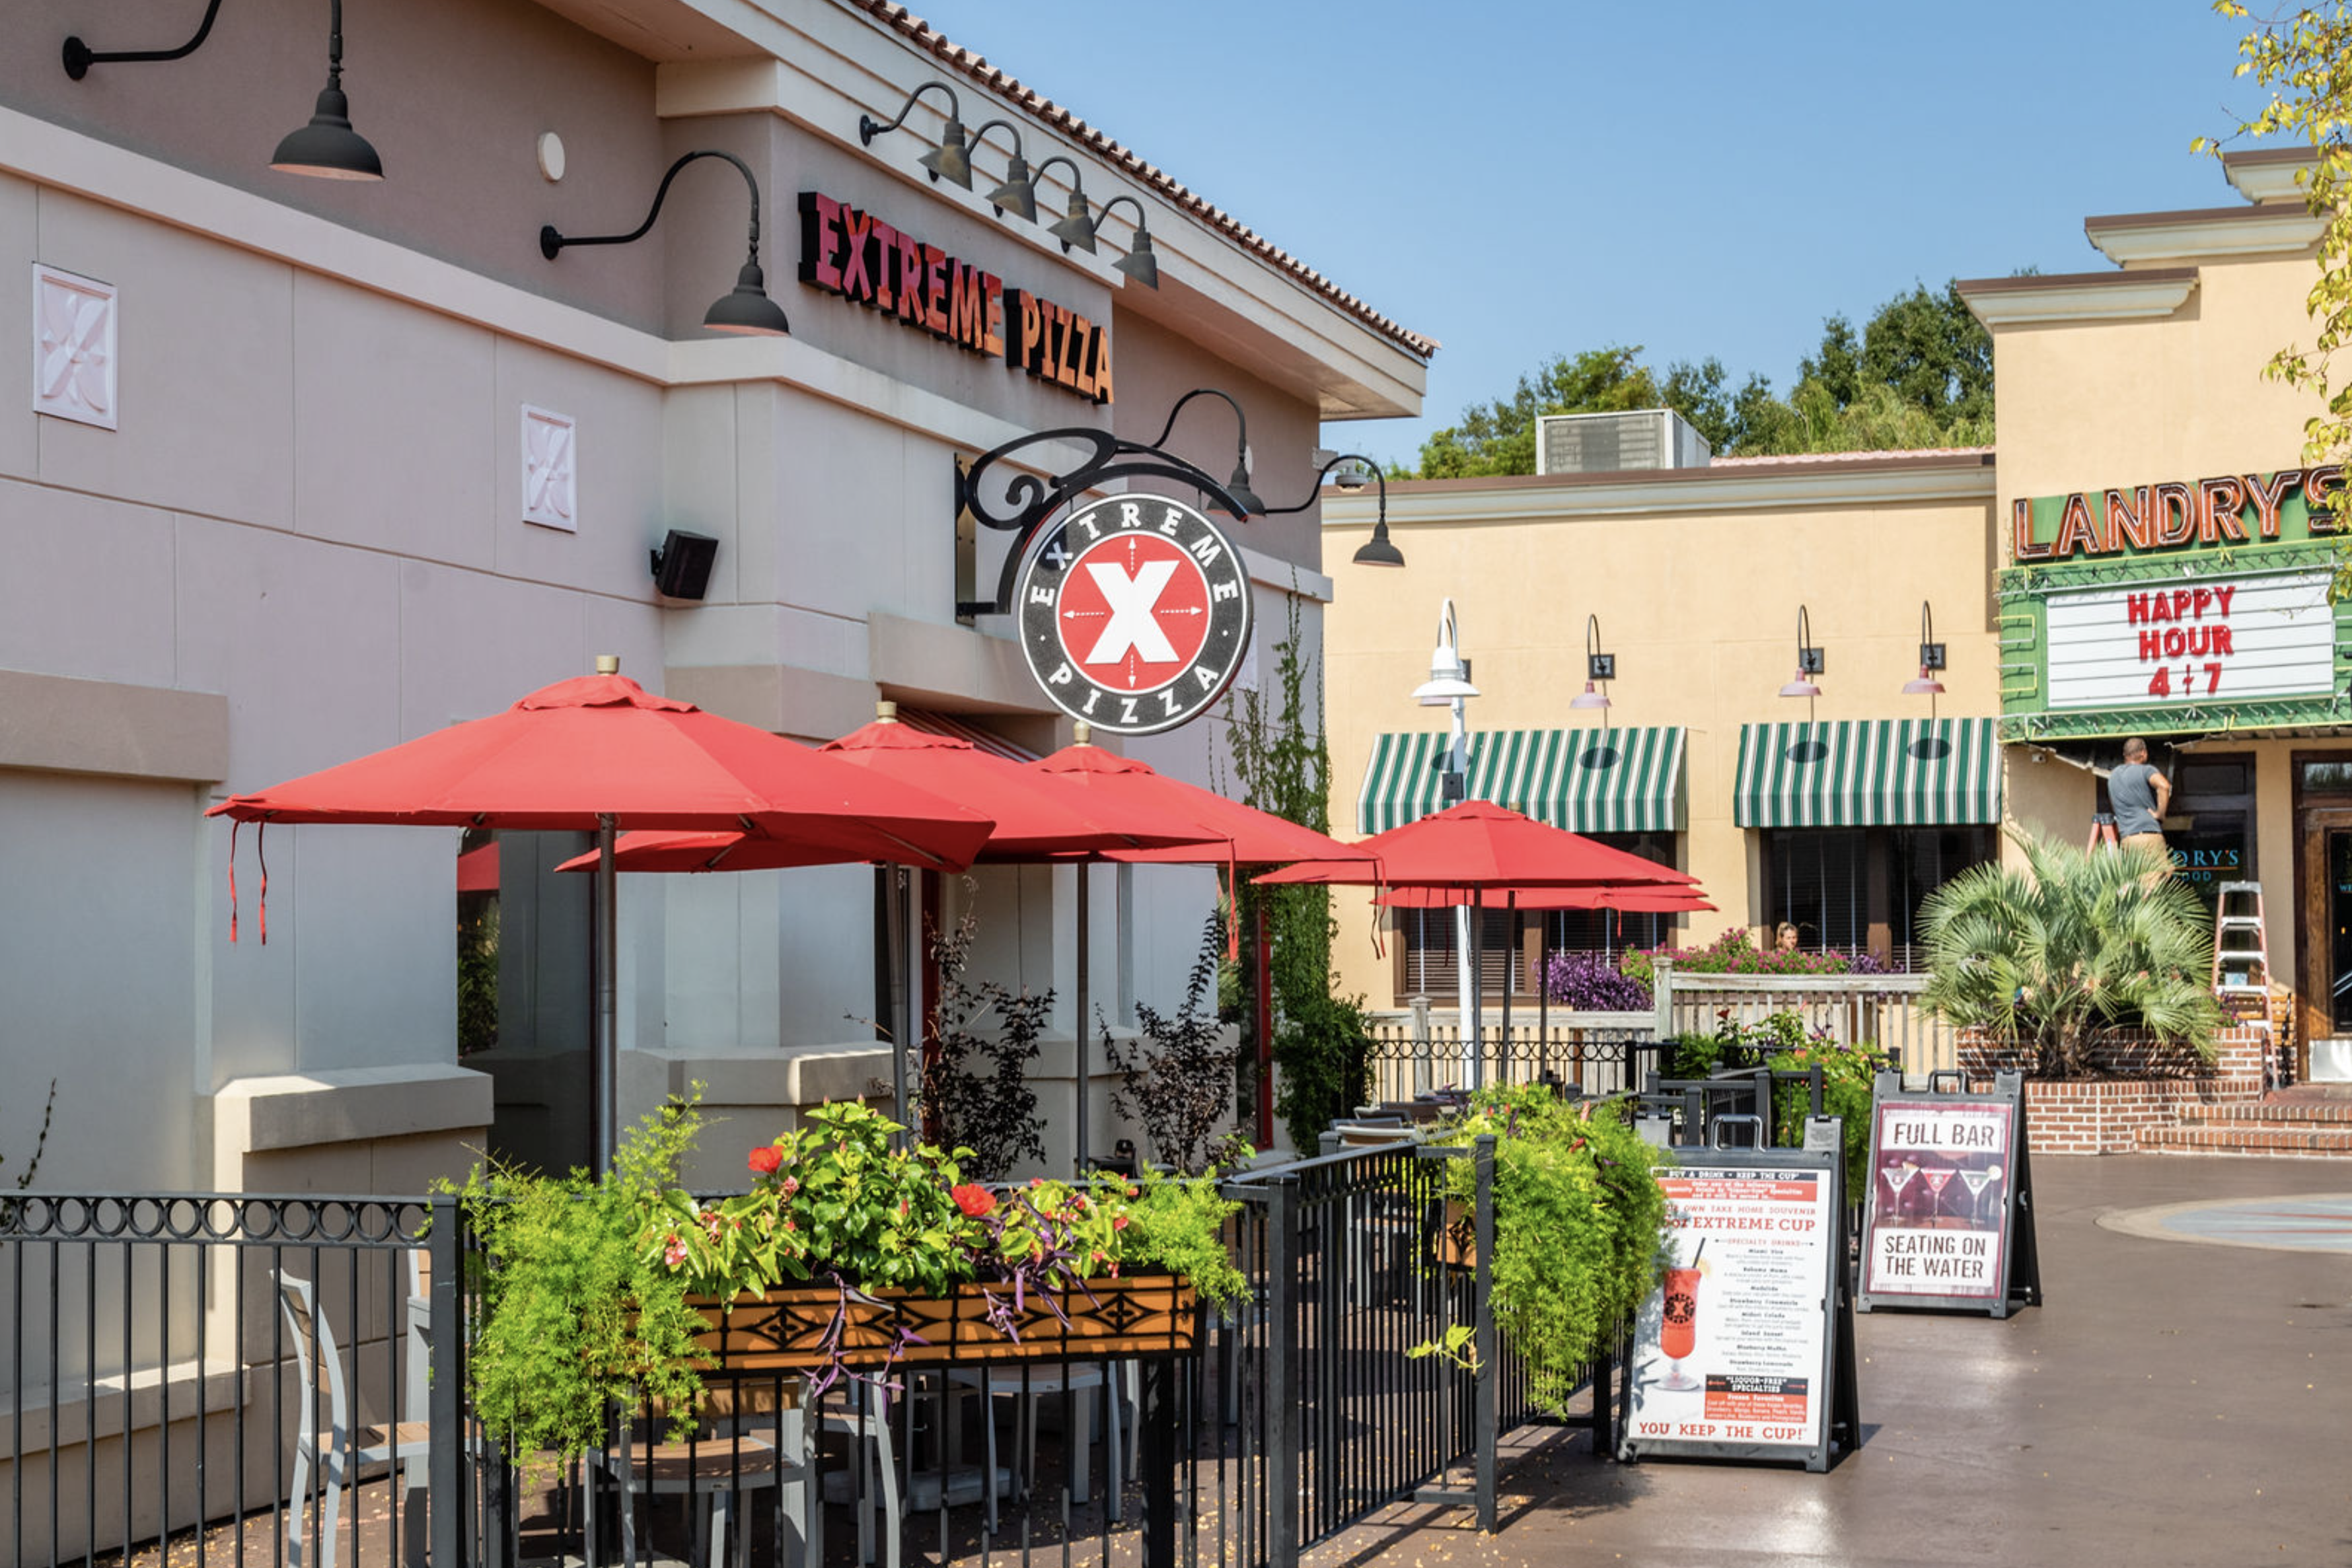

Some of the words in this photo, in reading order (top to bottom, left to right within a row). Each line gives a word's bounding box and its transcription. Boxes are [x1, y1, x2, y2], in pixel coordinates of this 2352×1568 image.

[799, 192, 1003, 357] EXTREME
[1004, 289, 1113, 404] PIZZA
[1030, 503, 1239, 606] EXTREME
[1085, 560, 1181, 664] X
[2127, 586, 2236, 625] HAPPY
[2139, 624, 2234, 662] HOUR
[1048, 660, 1220, 724] PIZZA
[2149, 666, 2171, 697] 4
[2204, 662, 2222, 695] 7
[1893, 1123, 1942, 1145] FULL
[1952, 1124, 1995, 1147] BAR
[1693, 1216, 1774, 1230] EXTREME
[1779, 1218, 1816, 1232] CUP
[1769, 1207, 1816, 1215] SOUVENIR
[1885, 1235, 1955, 1255] SEATING
[1962, 1237, 1986, 1256] ON
[1885, 1256, 1917, 1275] THE
[1923, 1258, 1984, 1279] WATER
[1732, 1384, 1781, 1393] SPECIALTIES
[1639, 1422, 1670, 1435] YOU
[1679, 1424, 1716, 1437] KEEP
[1726, 1425, 1754, 1437] THE
